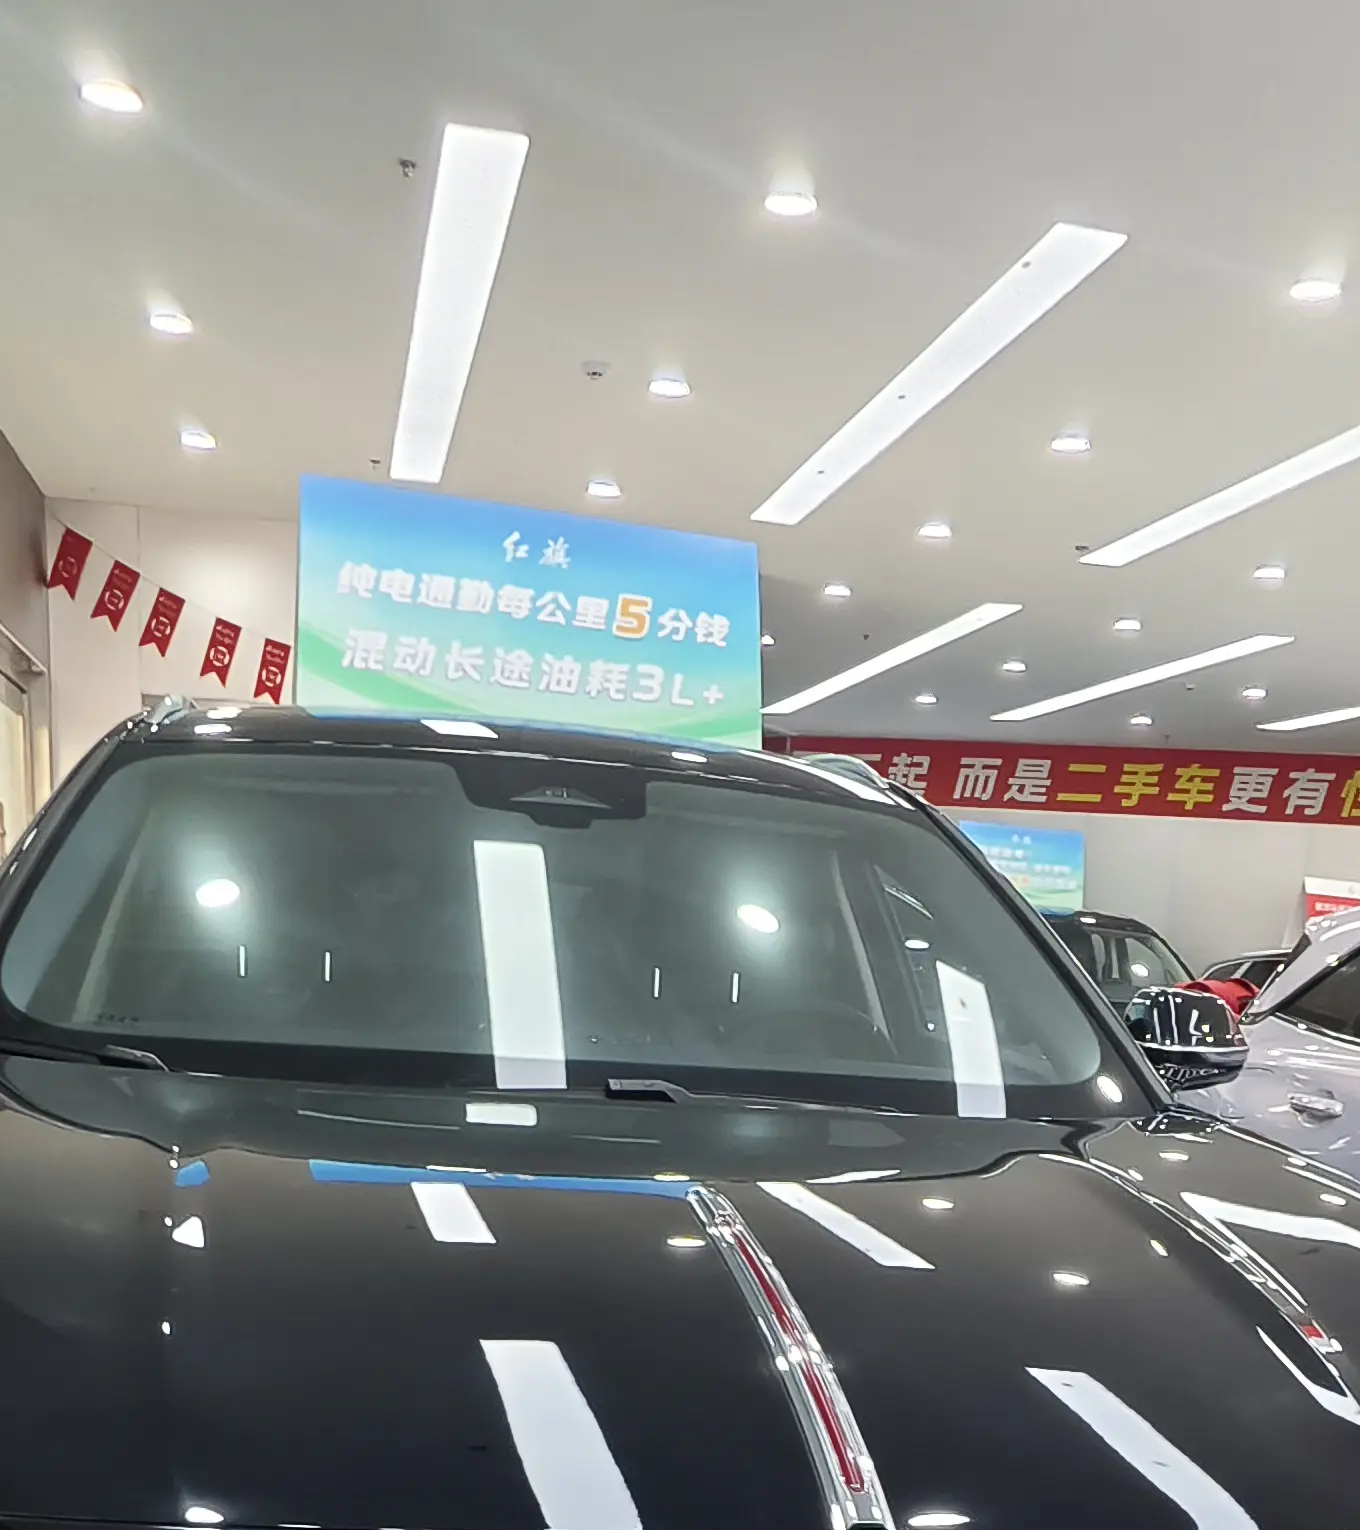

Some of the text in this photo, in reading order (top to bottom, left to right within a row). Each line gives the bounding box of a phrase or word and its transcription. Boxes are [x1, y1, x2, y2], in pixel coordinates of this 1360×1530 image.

[502, 531, 571, 569] 红旗
[337, 561, 731, 648] 纯电通勤每公里5分钱
